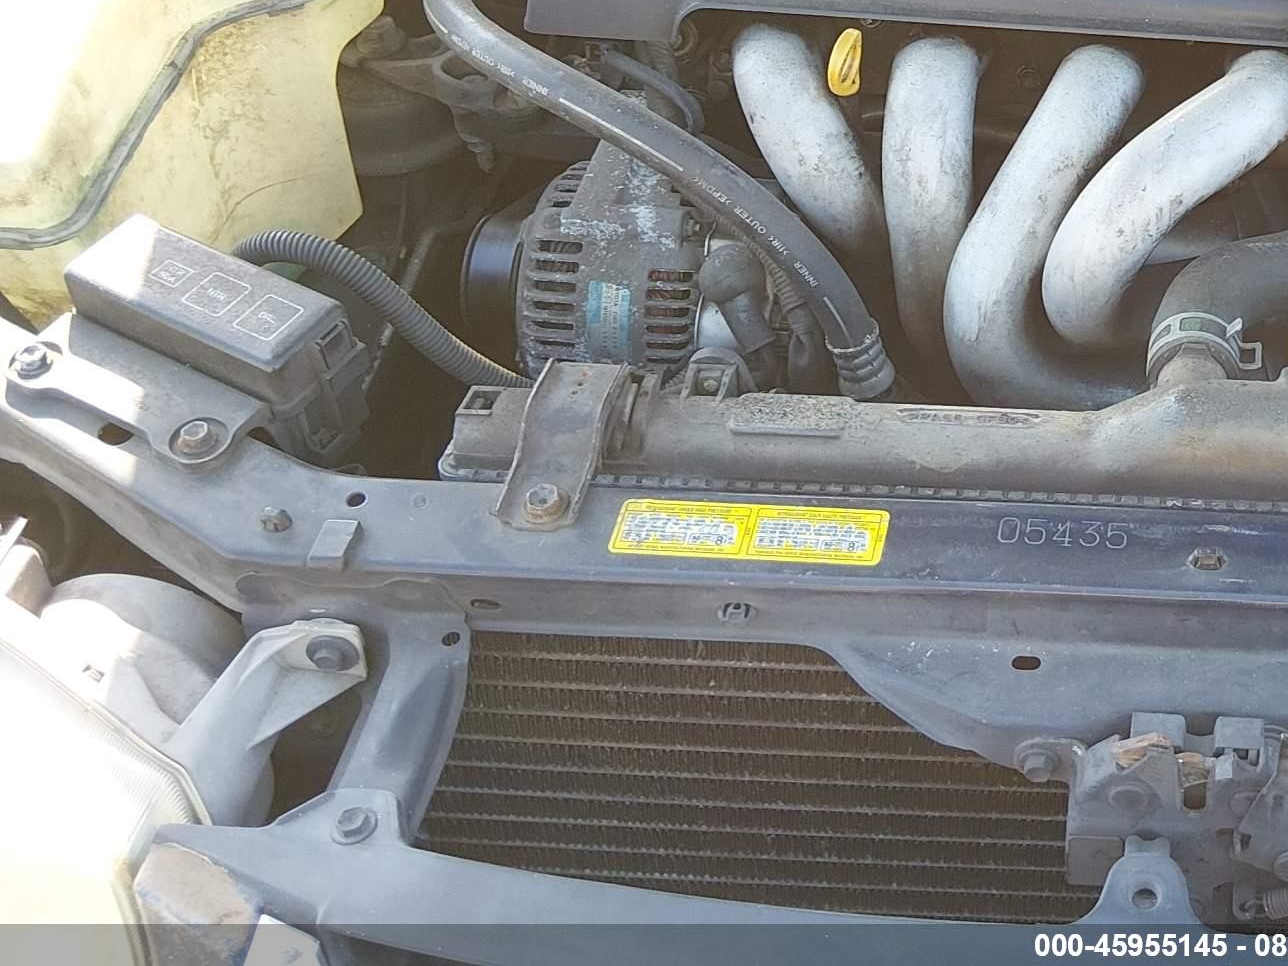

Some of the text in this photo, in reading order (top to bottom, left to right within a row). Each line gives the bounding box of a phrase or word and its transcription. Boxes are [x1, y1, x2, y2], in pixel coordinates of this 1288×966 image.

[734, 206, 767, 234] OUTER
[793, 260, 819, 289] INNER
[996, 516, 1129, 549] 05435
